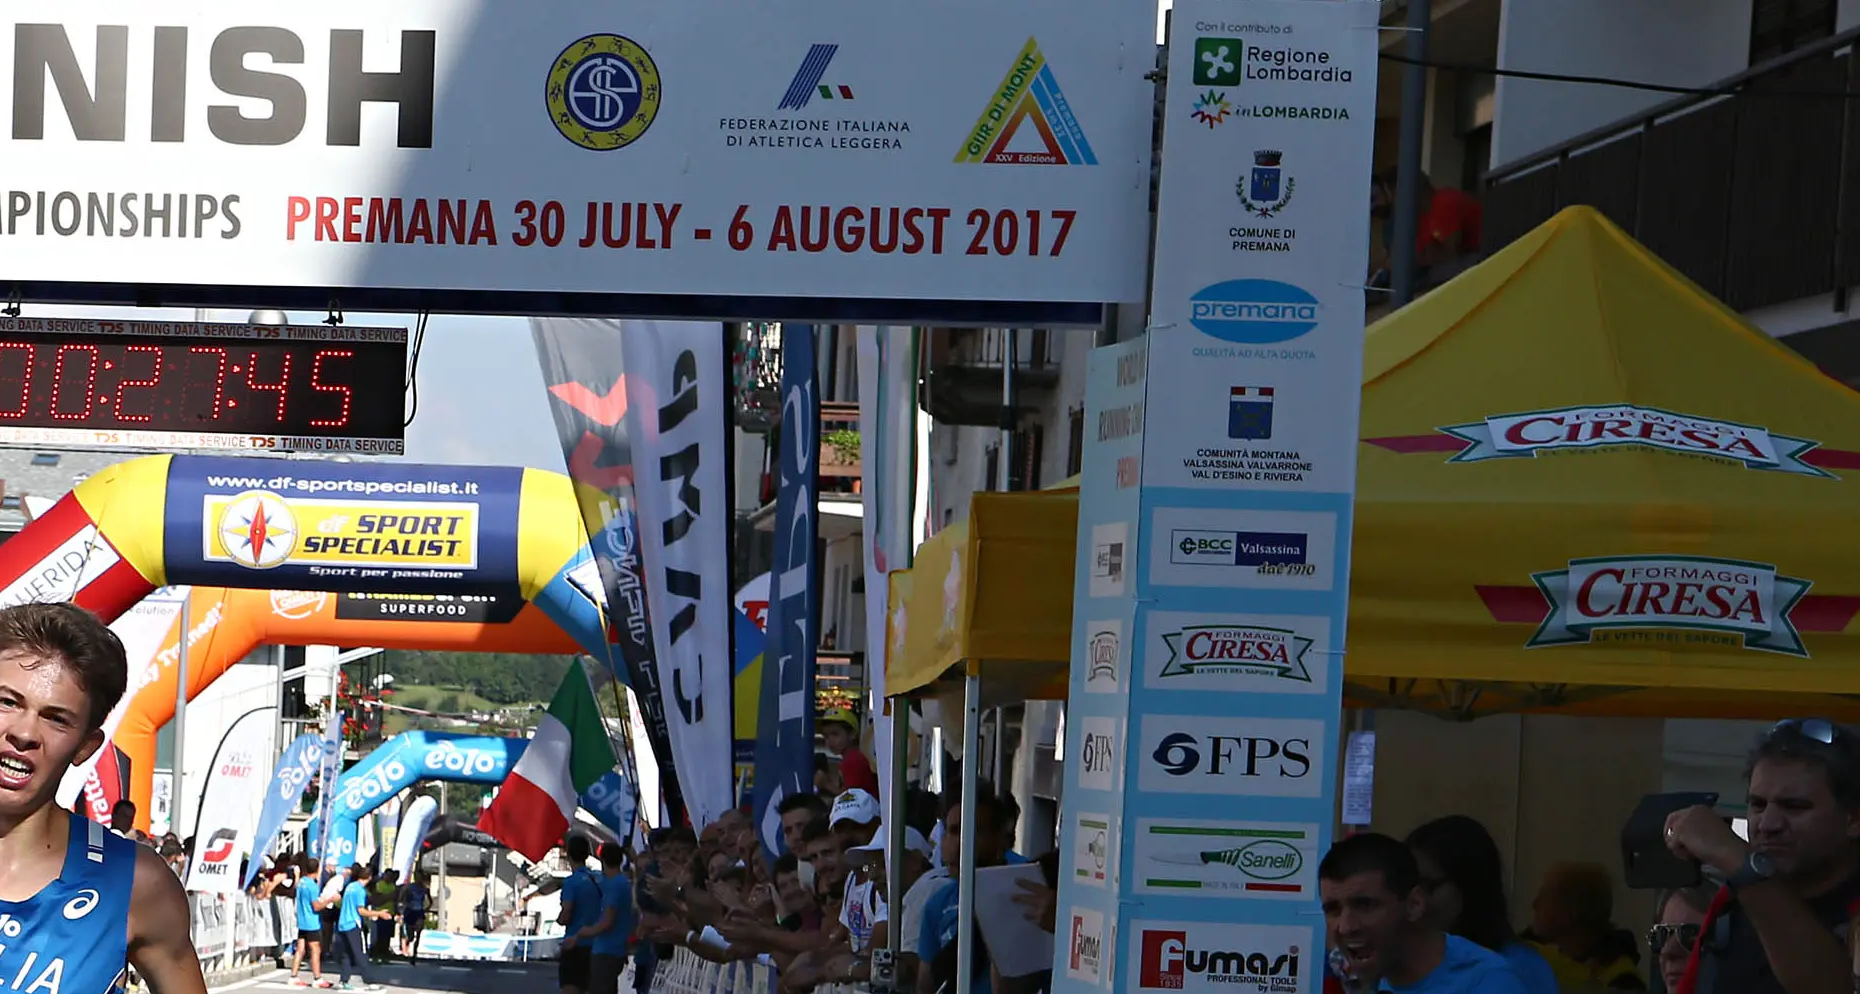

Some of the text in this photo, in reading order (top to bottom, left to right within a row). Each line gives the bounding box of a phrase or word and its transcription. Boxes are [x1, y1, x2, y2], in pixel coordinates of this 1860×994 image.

[1195, 21, 1281, 35] Con contributo
[1247, 46, 1330, 67] Regione
[1246, 67, 1352, 83] Lombardia
[1236, 105, 1350, 120] inLOMBARDIA
[720, 118, 911, 132] FEDERAZIONE ITALIANA
[726, 136, 903, 149] DI ATLETICA LEGGERA
[1018, 154, 1057, 163] Edizione
[286, 195, 1077, 257] PREMANA 30 JULY 6 AUGUST 2017
[1229, 227, 1296, 239] COMUNE DI
[1232, 241, 1291, 252] PREMANA
[1193, 302, 1315, 319] premana
[18, 319, 44, 331] DATA
[47, 320, 94, 333] SERVICE
[98, 321, 124, 333] TDS
[130, 322, 171, 334] TIMING
[174, 325, 199, 336] DATA
[203, 325, 251, 337] SERVICE
[254, 326, 281, 338] TDS
[286, 327, 327, 339] TIMING
[330, 328, 357, 340] DATA
[360, 329, 408, 341] SERVICE
[1255, 349, 1279, 359] ALTA
[1280, 350, 1316, 361] QUOTA
[1575, 410, 1746, 437] FORMAGGI
[198, 435, 403, 451] SERVICE TDS TIMING DATA SERVICE
[1504, 416, 1770, 460] CIRESA
[1196, 447, 1300, 460] COMUNITÀ MONTANA
[1183, 458, 1313, 472] VALSASSINA VALVARRONE
[1192, 469, 1304, 483] VAL D'ESINO RIVIERA
[207, 474, 479, 495] www.df-sportspecialist.it
[357, 514, 464, 536] SPORT
[303, 536, 462, 557] SPECIALIST
[1197, 538, 1233, 551] BCC
[1241, 543, 1301, 556] Valsassina
[308, 566, 464, 580] Sport per passione
[1284, 563, 1315, 576] 1910
[1631, 566, 1758, 586] FORMAGGI
[1576, 568, 1767, 625] CIRESA
[380, 603, 467, 616] SUPERFOOD
[1215, 631, 1286, 643] FORMAGGI
[1684, 634, 1738, 646] SAPORE
[1185, 631, 1290, 664] CIRESA
[425, 740, 495, 776] eolo
[1205, 735, 1310, 778] FPS
[281, 743, 321, 801] eolo
[345, 758, 406, 810] eolo
[1242, 852, 1296, 870] Sanelli
[197, 863, 228, 876] OMET
[1207, 974, 1297, 986] PROFESSIONAL TOOLS
[1257, 984, 1268, 993] by
